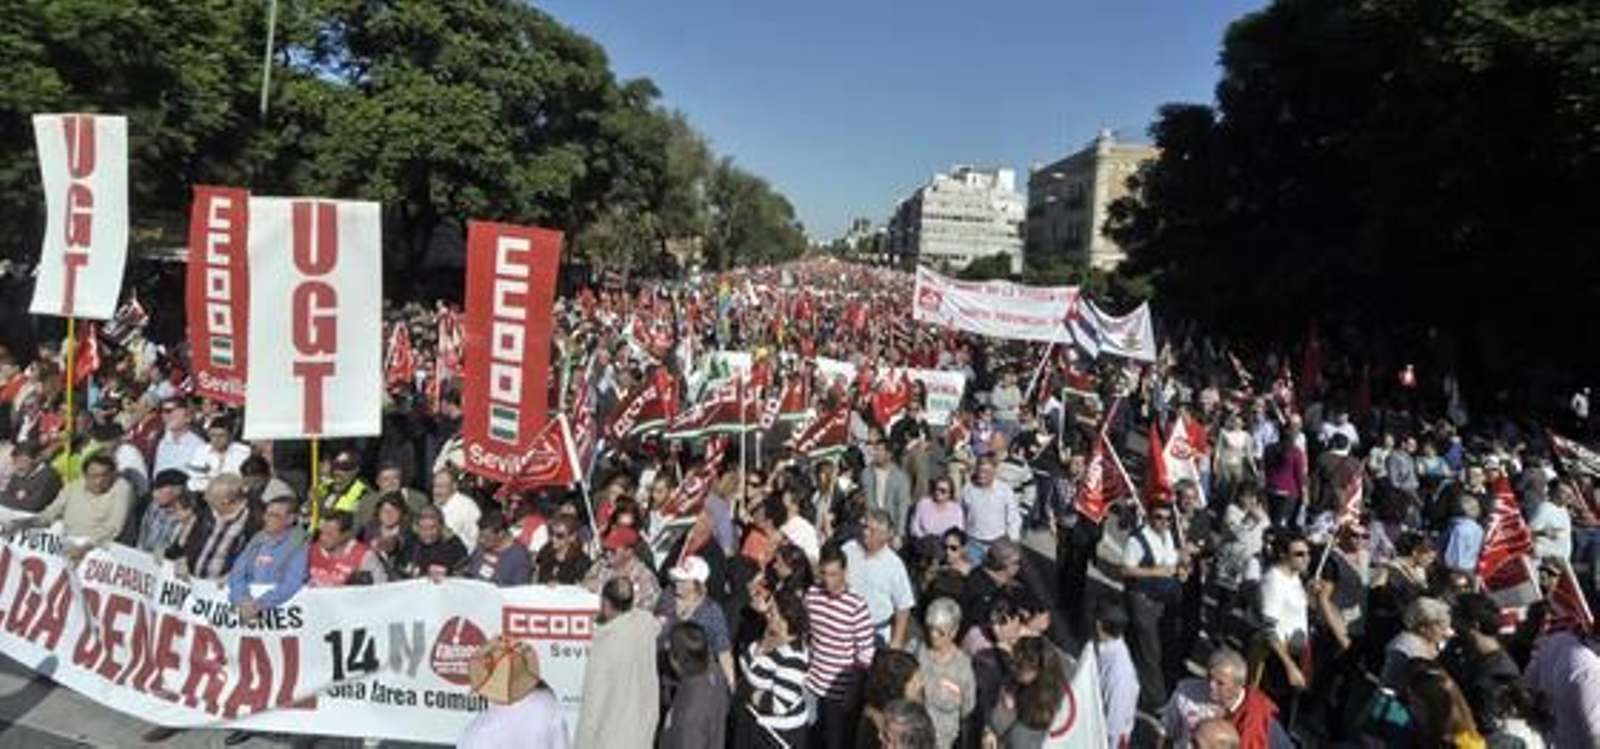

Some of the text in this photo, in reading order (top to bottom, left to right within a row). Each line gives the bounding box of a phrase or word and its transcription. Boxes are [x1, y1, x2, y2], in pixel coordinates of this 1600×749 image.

[62, 114, 97, 317] UGT
[206, 197, 234, 335] CCOO
[292, 201, 338, 434] UGT
[489, 236, 531, 405] CCOO
[73, 587, 318, 719] GENERAL
[509, 612, 589, 633] CCOO
